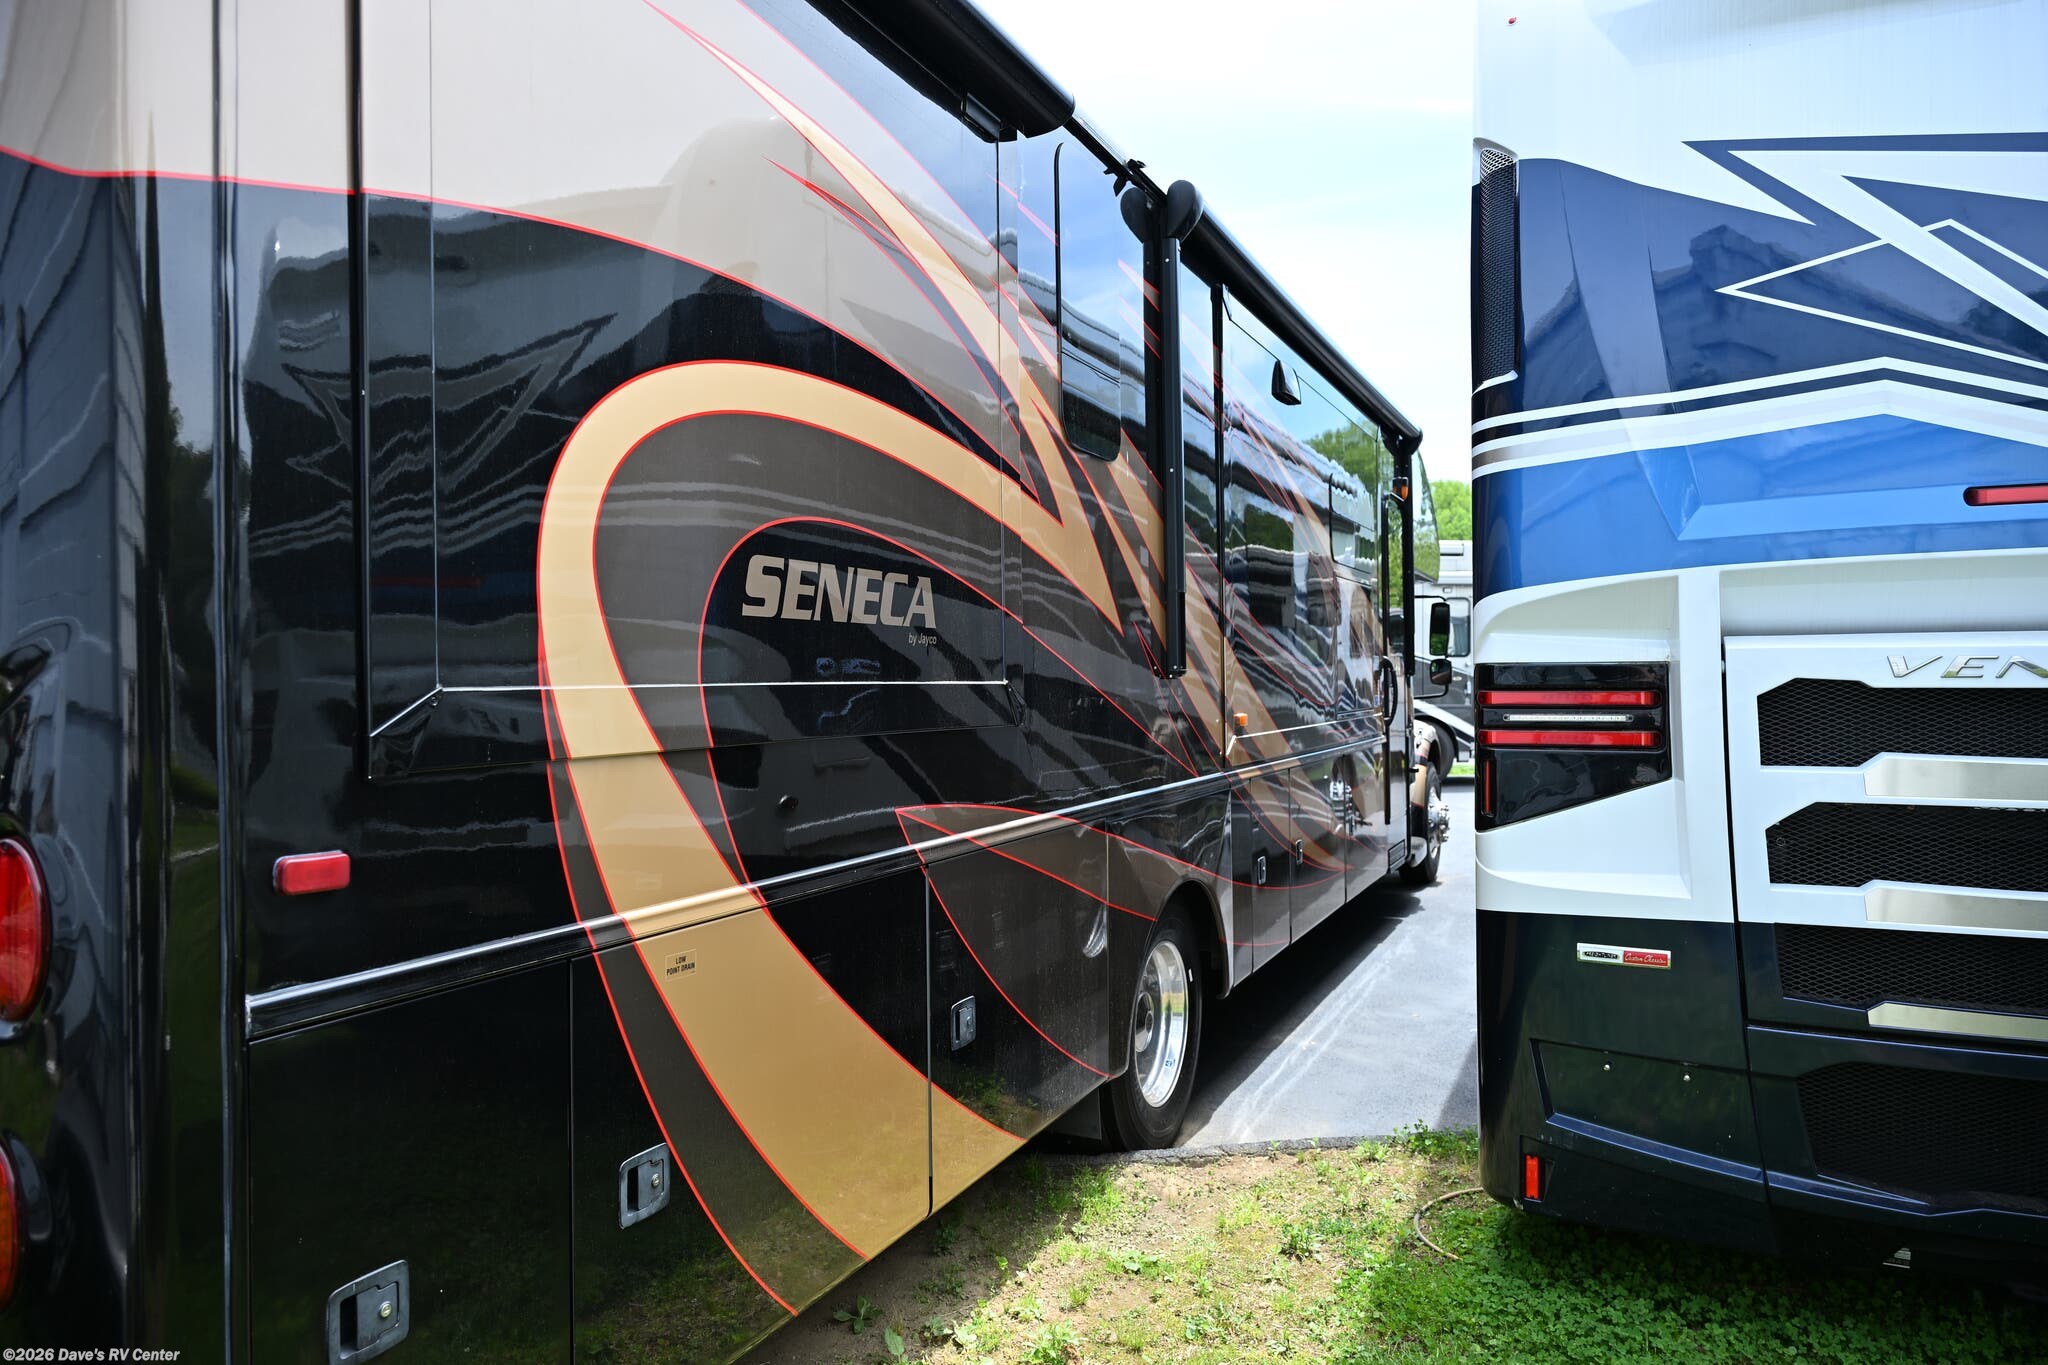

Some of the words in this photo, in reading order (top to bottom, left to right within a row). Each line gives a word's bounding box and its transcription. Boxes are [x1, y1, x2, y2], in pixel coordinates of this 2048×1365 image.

[742, 554, 937, 628] SENECA
[908, 632, 918, 647] by
[918, 632, 937, 647] Jayco
[675, 955, 687, 965] LOW
[666, 965, 680, 976] POINT
[681, 962, 695, 972] DRAIN
